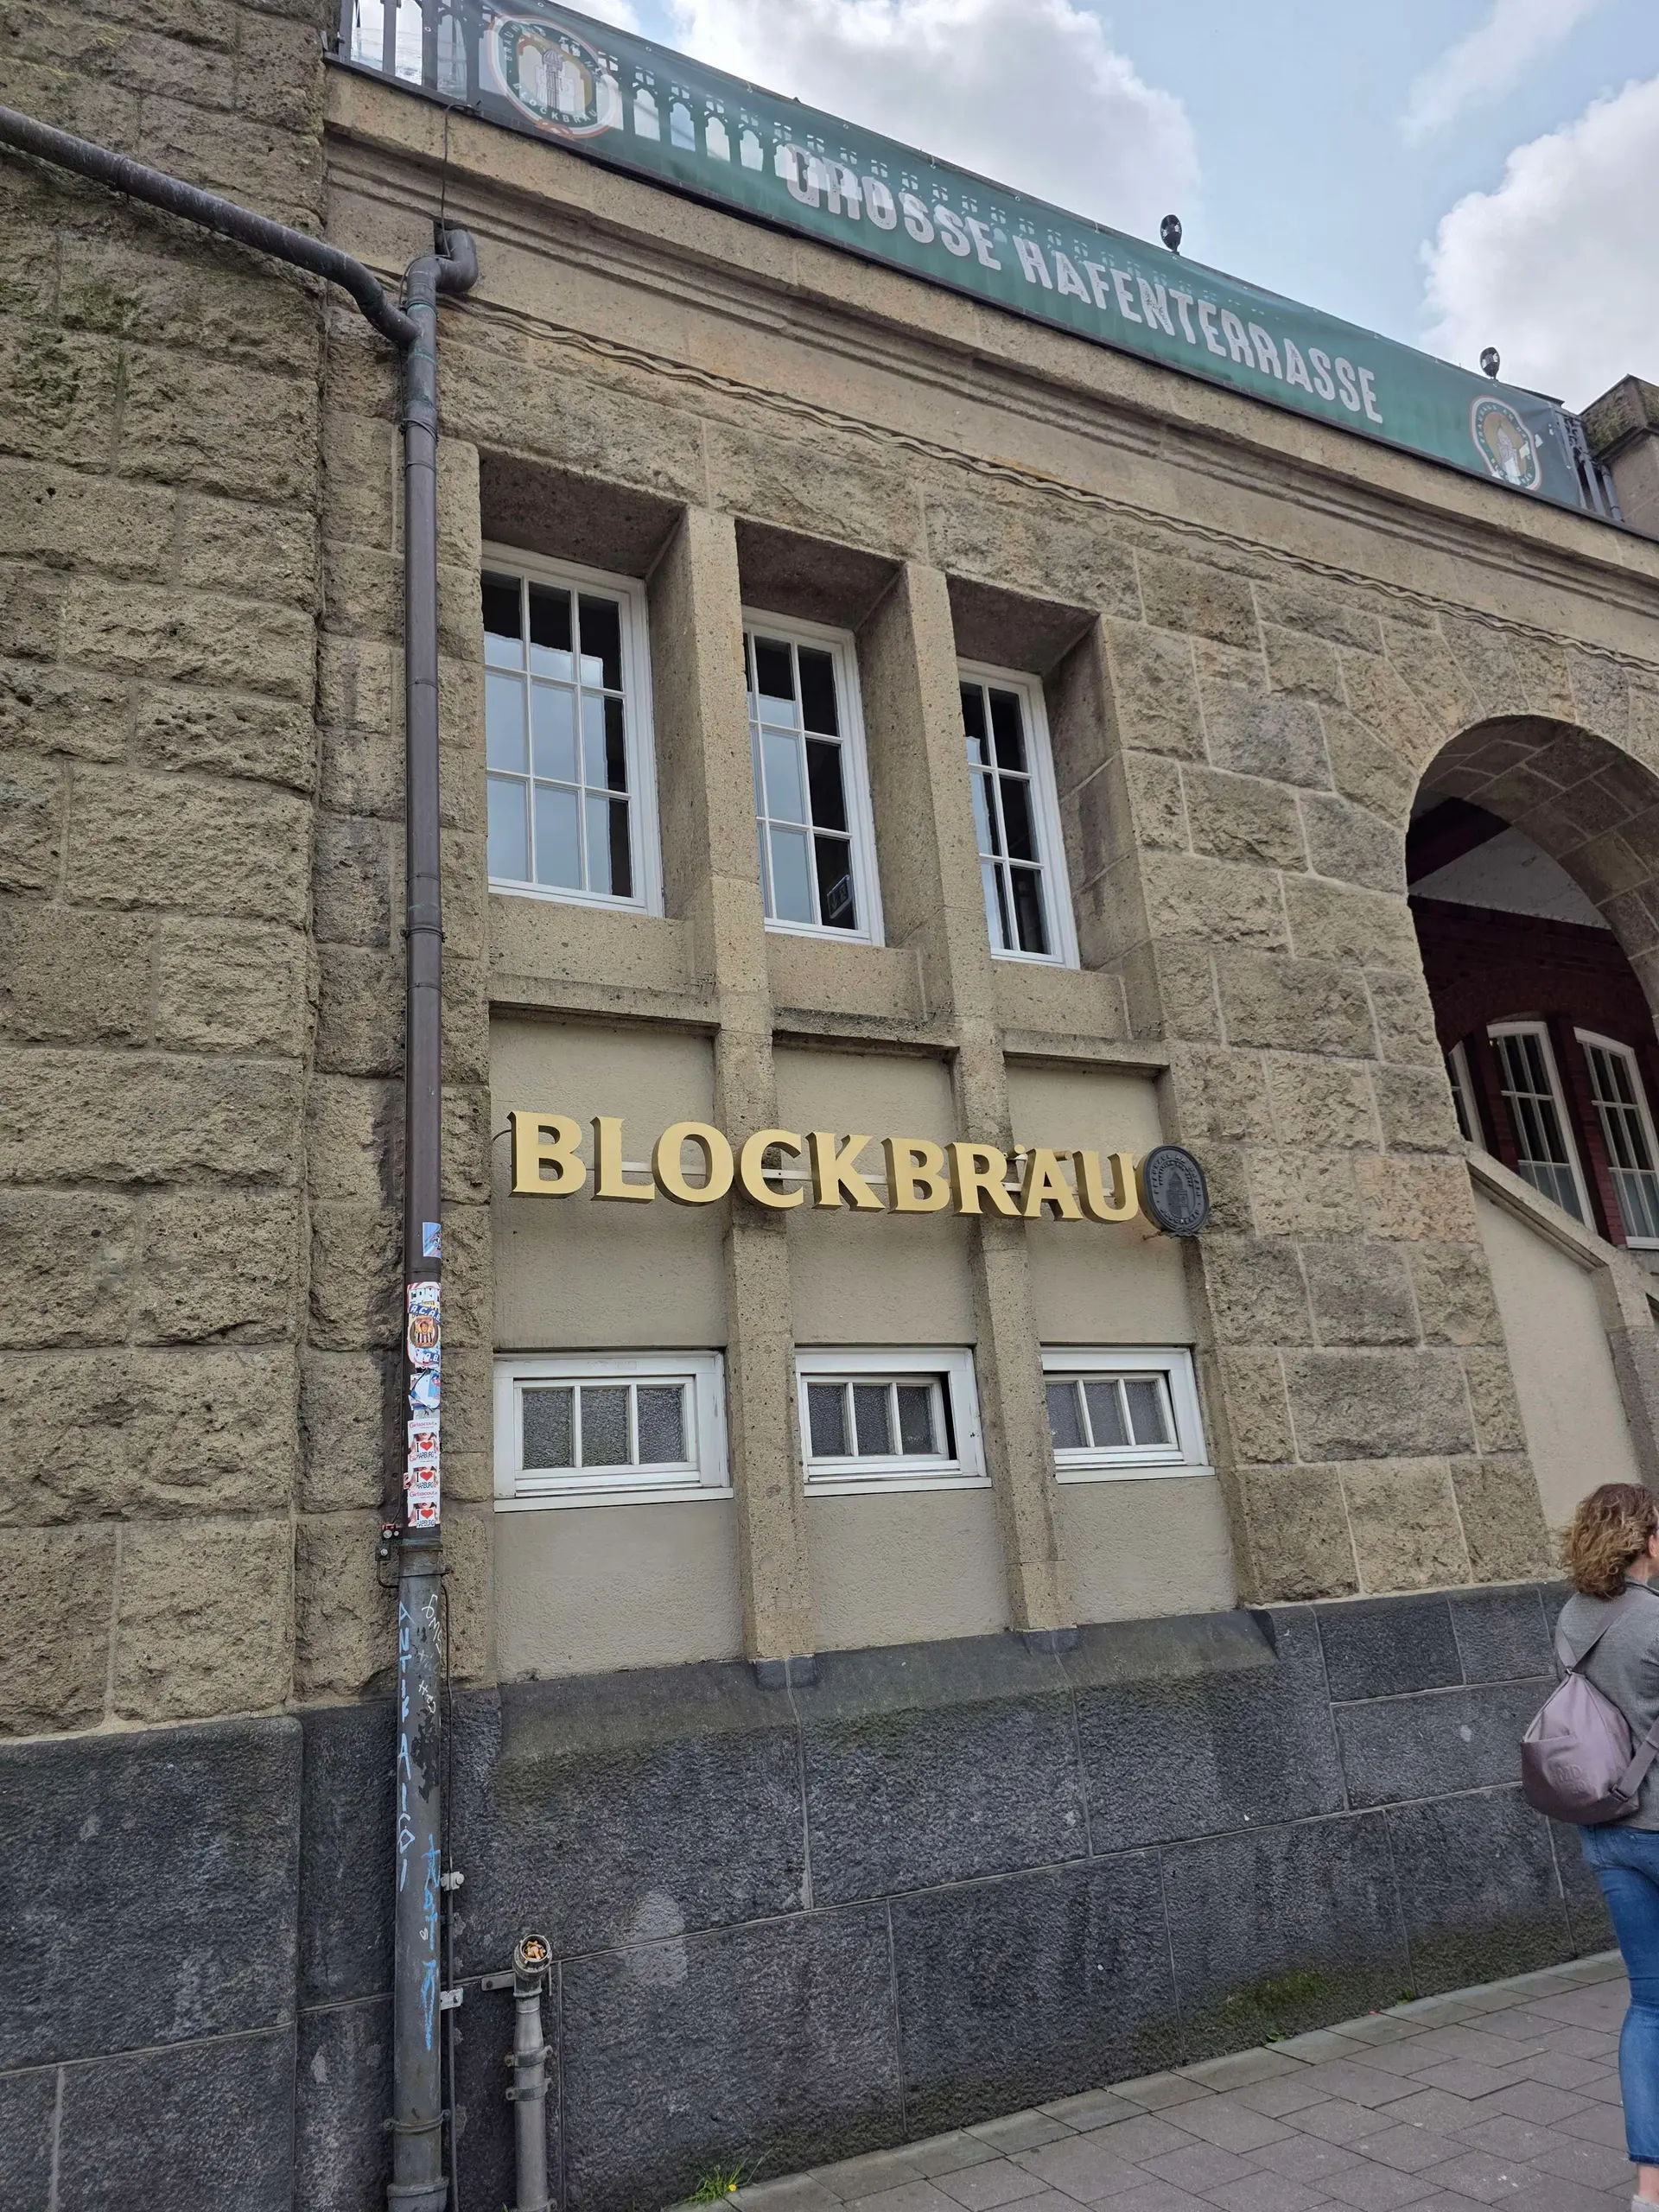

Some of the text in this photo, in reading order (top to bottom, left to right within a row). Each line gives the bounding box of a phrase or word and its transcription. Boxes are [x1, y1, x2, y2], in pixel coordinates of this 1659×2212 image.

[785, 143, 1382, 423] GROSSE HAFENTERRASSE
[507, 1111, 1140, 1224] BLOCKBRÄU
